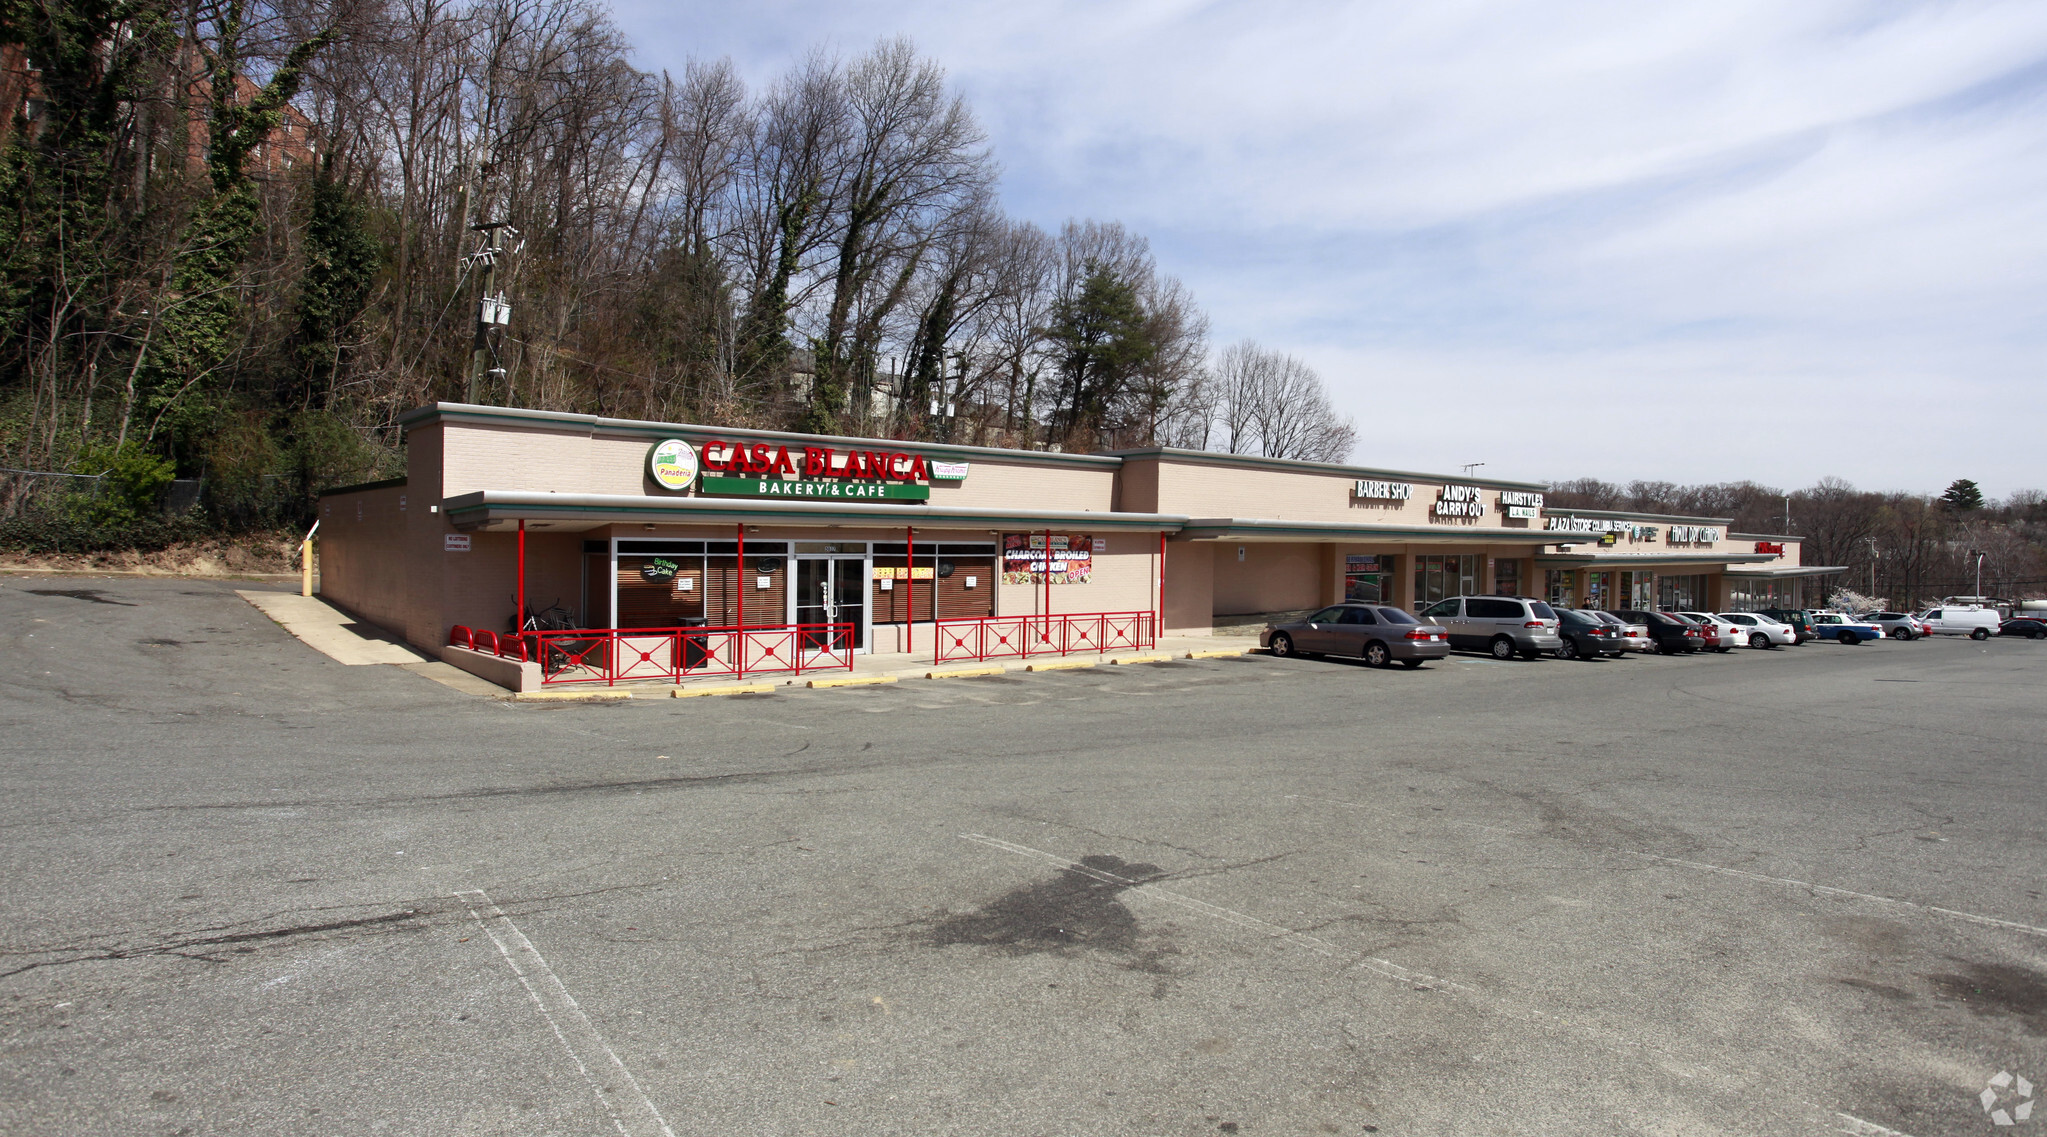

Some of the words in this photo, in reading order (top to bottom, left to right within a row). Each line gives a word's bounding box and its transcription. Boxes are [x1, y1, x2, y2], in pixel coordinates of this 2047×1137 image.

[702, 440, 795, 475] CASA
[803, 446, 929, 481] BLANCA
[759, 481, 825, 496] BAKERY
[831, 484, 840, 496] &
[846, 484, 885, 497] CAFE
[1357, 481, 1389, 498] BARBER
[1391, 483, 1414, 500] SHOP
[1443, 485, 1481, 502] ANDY'S
[1502, 491, 1544, 508] HAIRSTYLES
[1436, 501, 1468, 516] CARRY
[1468, 503, 1487, 517] OUT
[1521, 508, 1536, 518] NAILS
[1550, 517, 1570, 530] PLAZA
[1054, 551, 1089, 560] BROILED
[654, 557, 679, 571] Birthday
[657, 566, 673, 577] Cake
